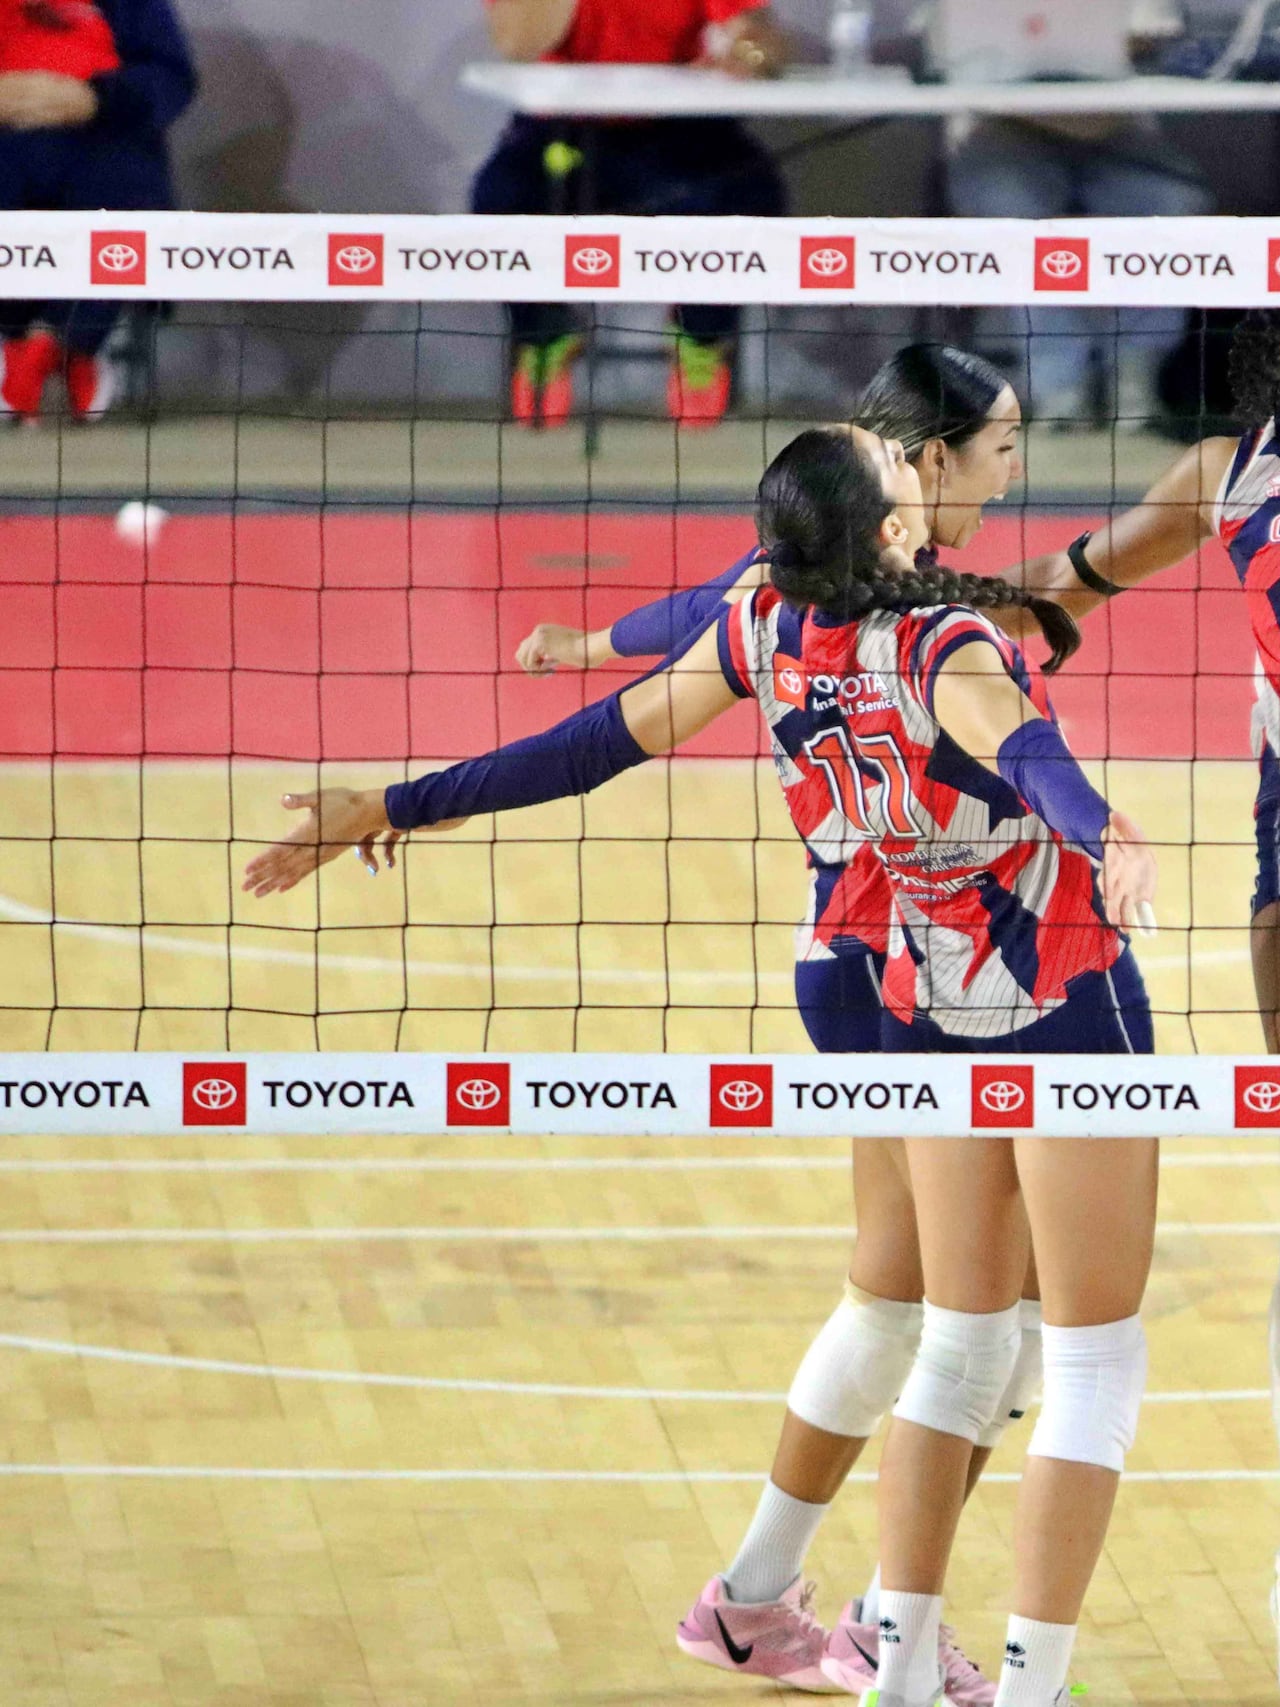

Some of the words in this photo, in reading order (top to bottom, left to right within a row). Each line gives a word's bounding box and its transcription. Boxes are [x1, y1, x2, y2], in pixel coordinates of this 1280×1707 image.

[0, 245, 56, 268] OTA
[162, 248, 294, 270] TOYOTA
[399, 248, 531, 271] TOYOTA
[636, 250, 766, 273] TOYOTA
[870, 251, 1000, 275] TOYOTA
[1104, 253, 1234, 276] TOYOTA
[0, 1080, 150, 1108] TOYOTA
[263, 1080, 415, 1108] TOYOTA
[526, 1081, 677, 1109] TOYOTA
[789, 1082, 939, 1110] TOYOTA
[1050, 1082, 1199, 1110] TOYOTA
